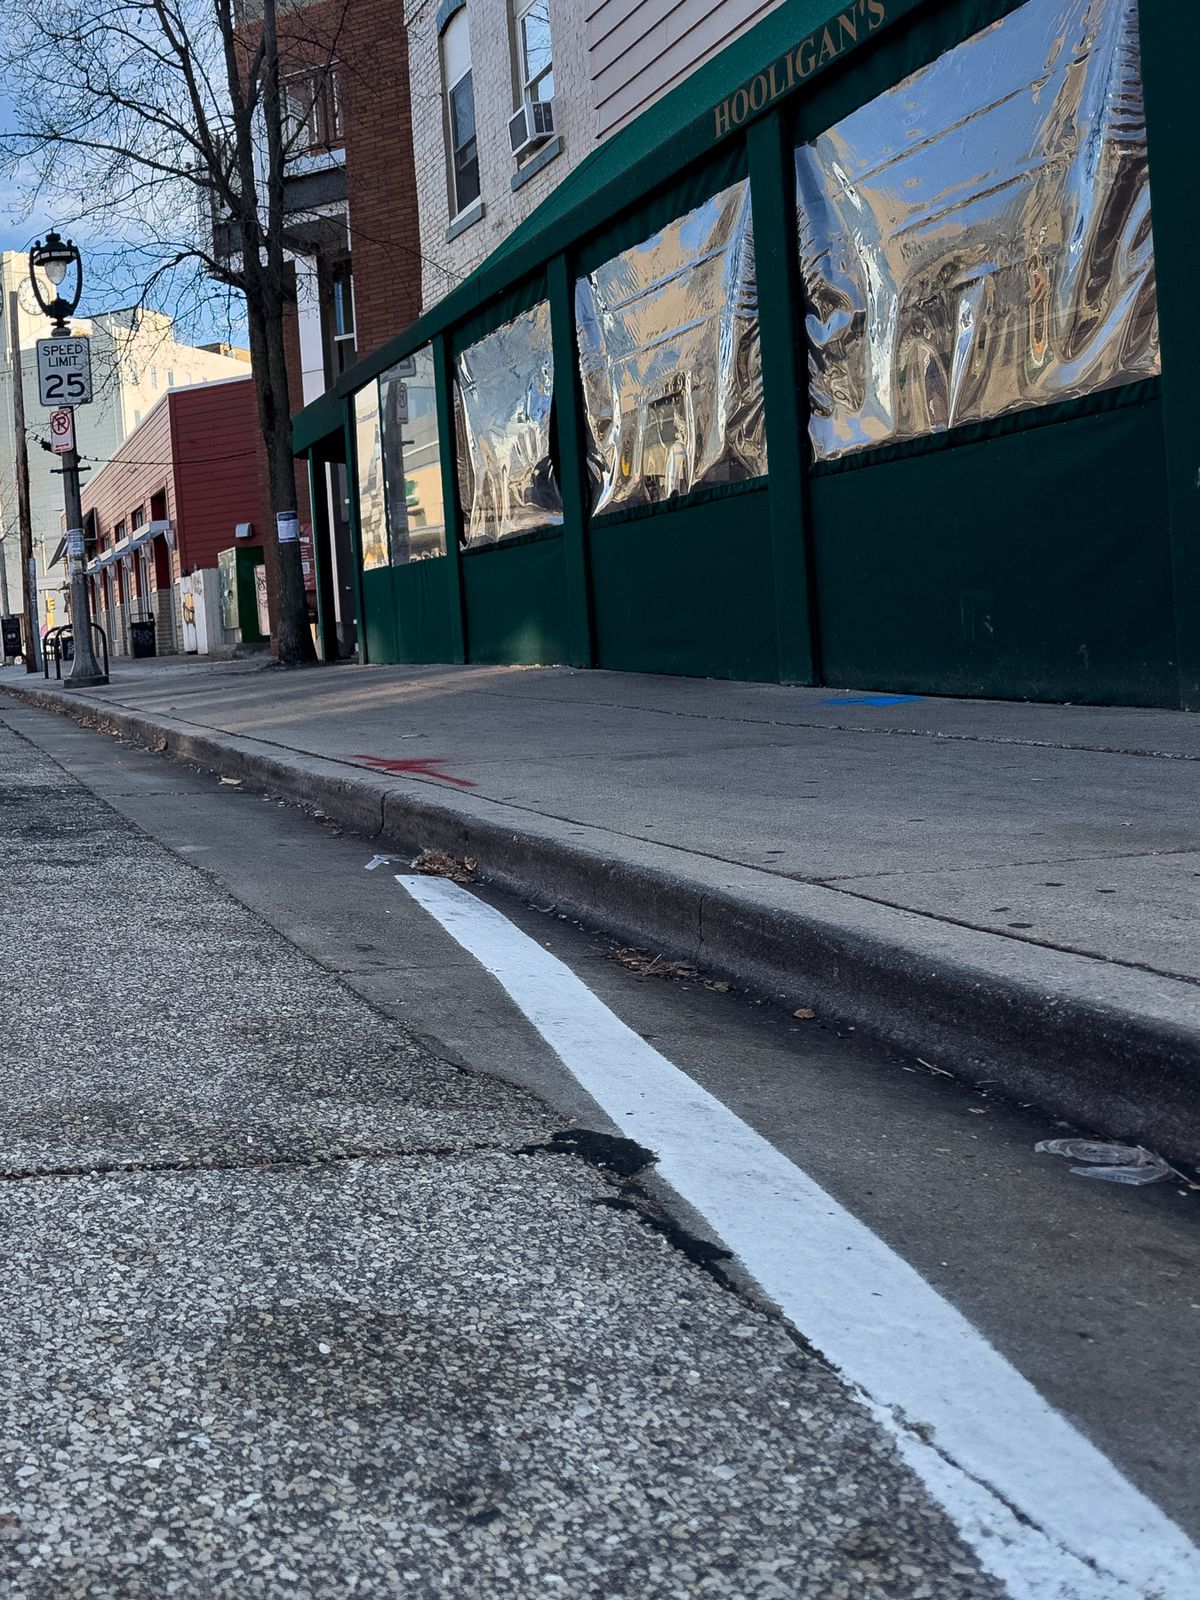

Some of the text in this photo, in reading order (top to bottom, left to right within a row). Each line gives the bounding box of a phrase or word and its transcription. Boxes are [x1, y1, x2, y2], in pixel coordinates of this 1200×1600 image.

[713, 0, 886, 139] HOOLIGAN'S
[42, 344, 83, 356] SPEED
[48, 355, 79, 368] LIMIT
[44, 373, 86, 399] 25
